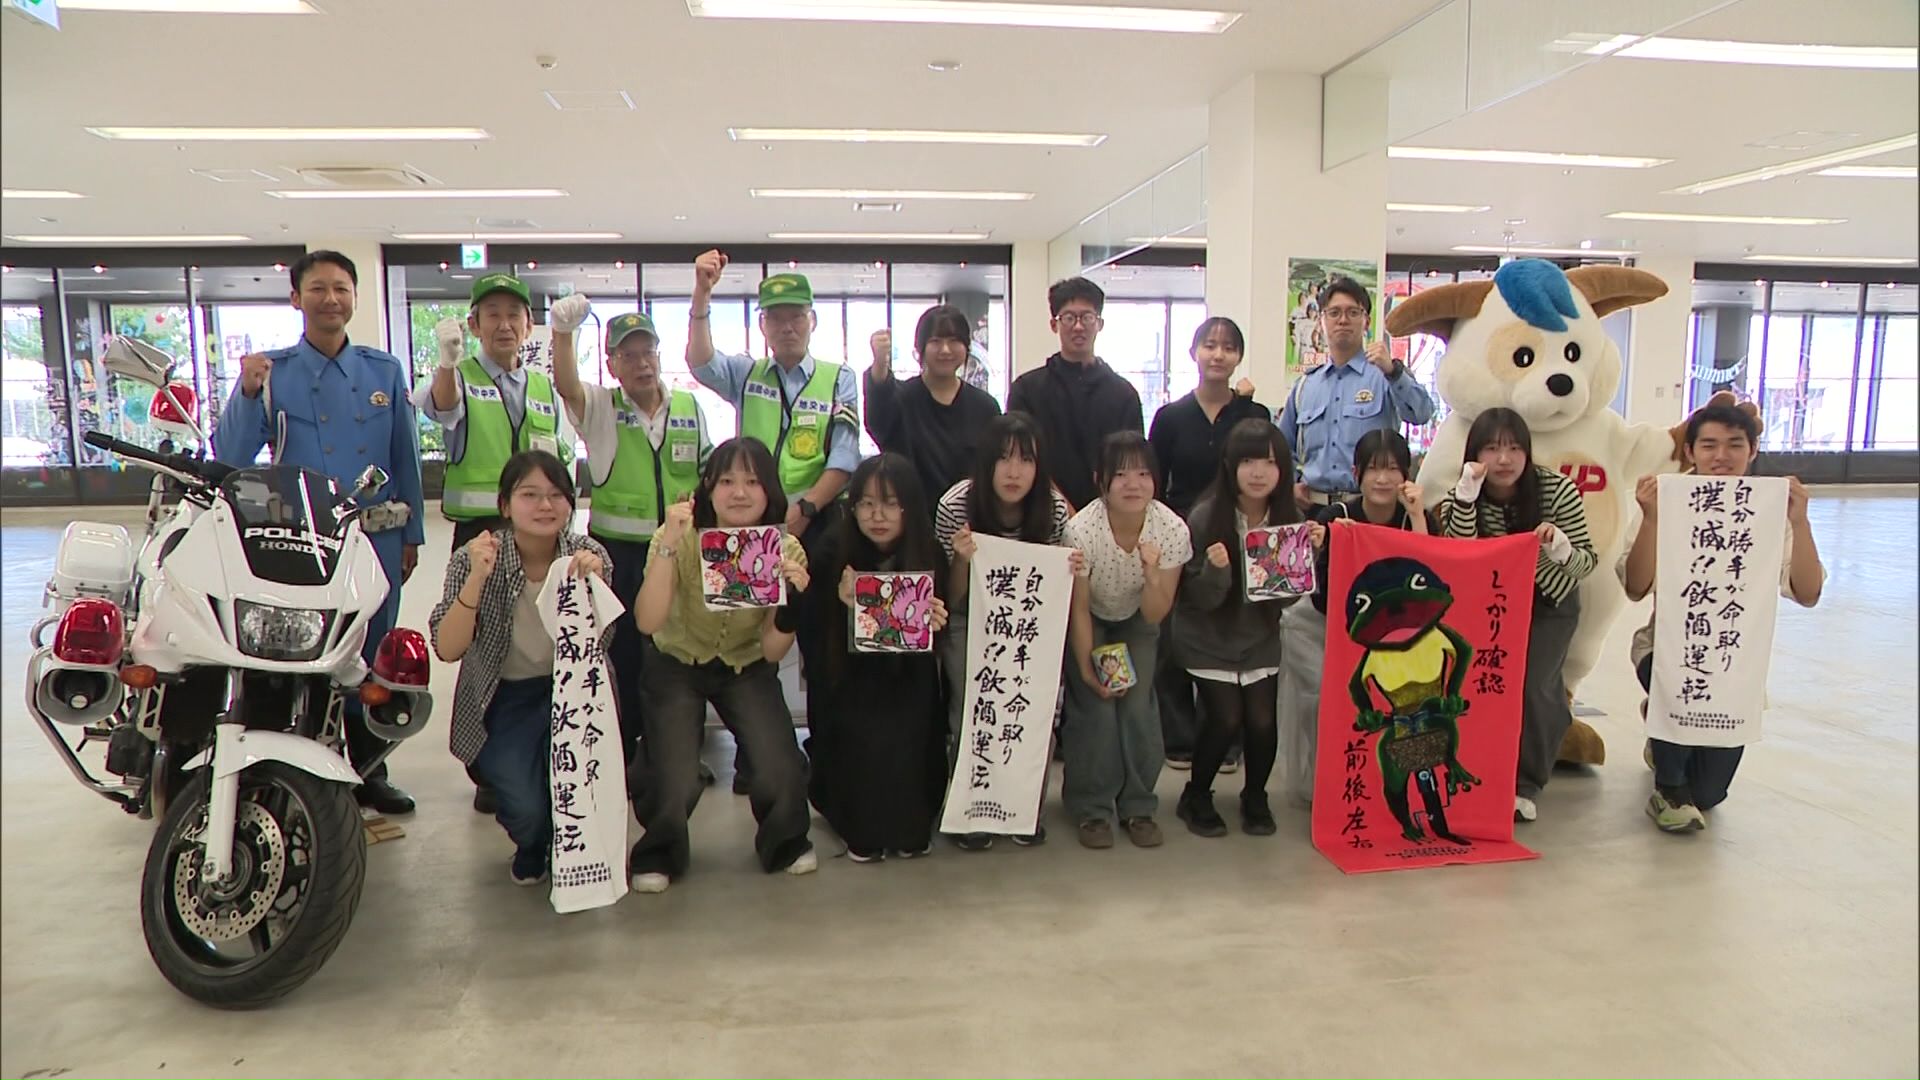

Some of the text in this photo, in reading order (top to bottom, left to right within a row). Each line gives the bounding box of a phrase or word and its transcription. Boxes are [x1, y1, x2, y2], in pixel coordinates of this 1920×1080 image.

[244, 526, 342, 552] POLICE
[259, 540, 328, 559] HONDA
[1714, 480, 1756, 672] 自分勝手が命取り
[997, 565, 1044, 765] 自分勝手が命取り
[1341, 736, 1375, 849] 前後左右
